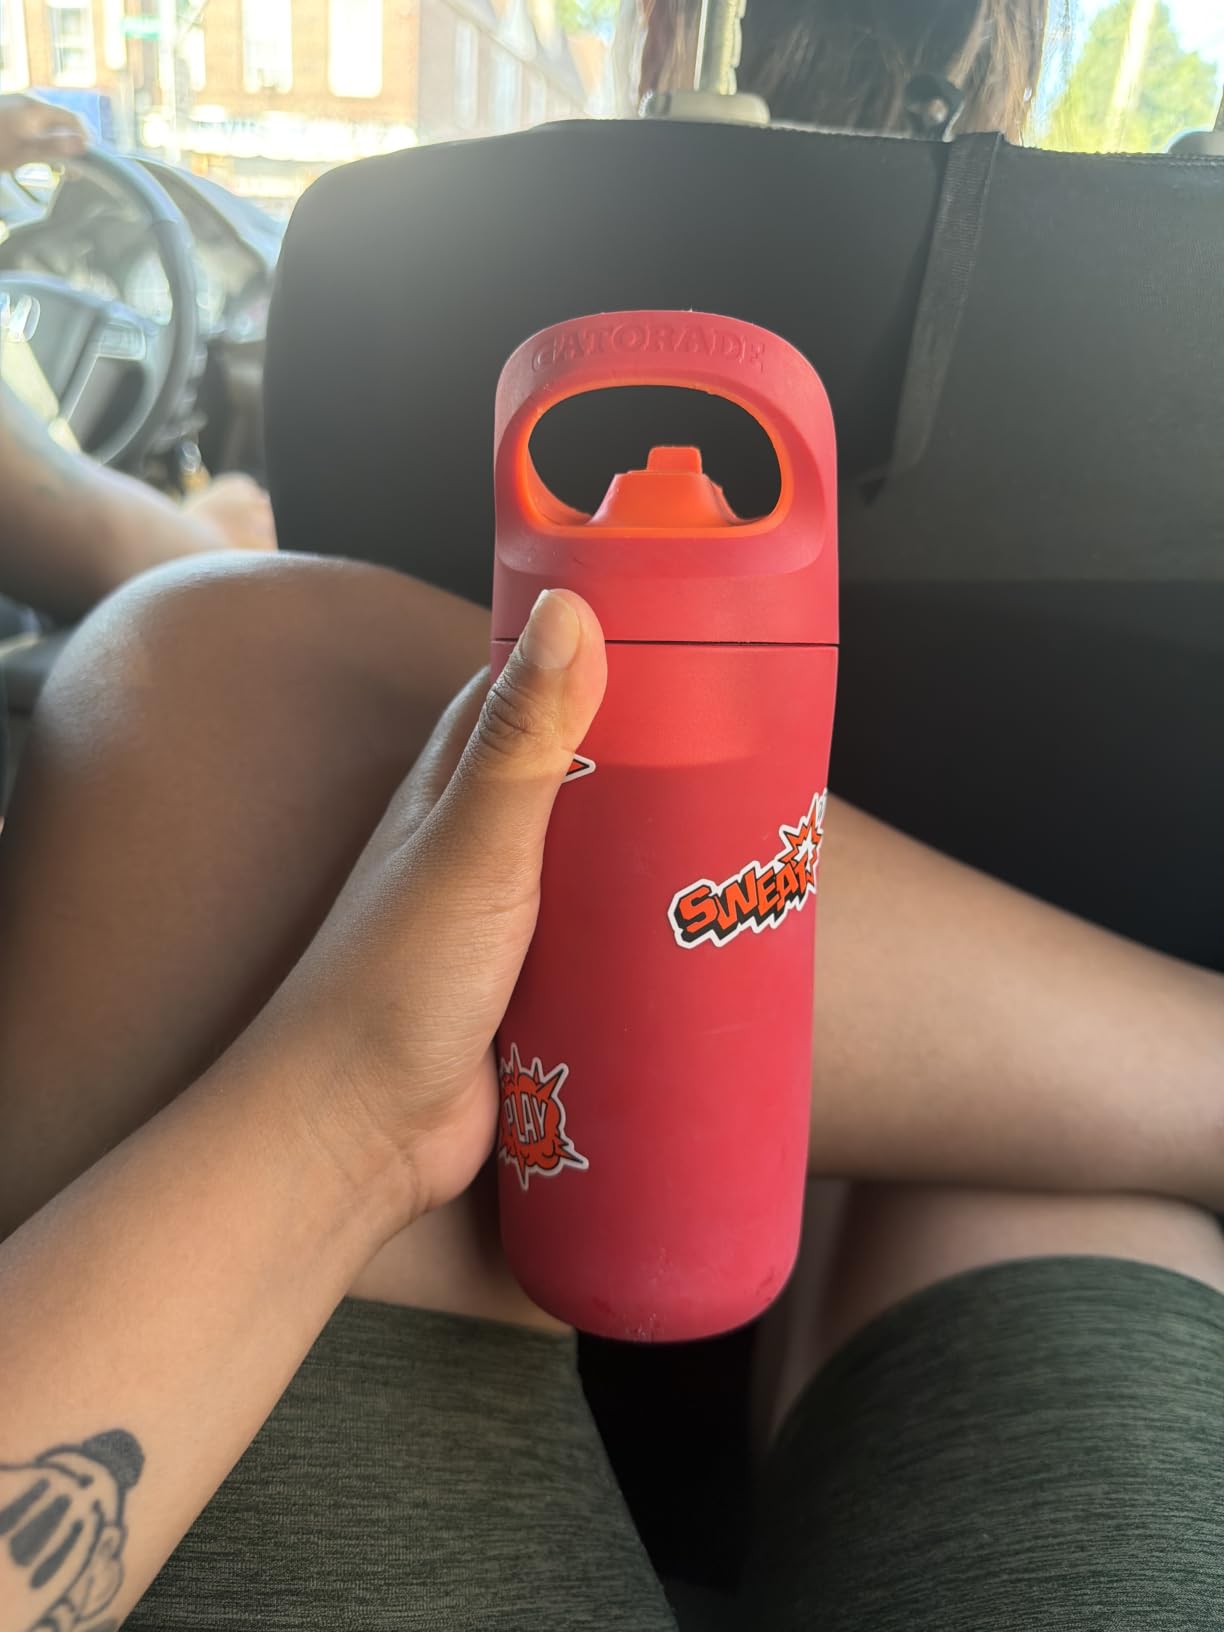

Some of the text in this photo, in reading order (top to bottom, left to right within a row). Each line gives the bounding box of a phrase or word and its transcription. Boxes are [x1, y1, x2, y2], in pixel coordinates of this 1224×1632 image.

[532, 322, 765, 373] GATORADE
[674, 852, 810, 942] SWEAT
[503, 1092, 547, 1143] PLAY
